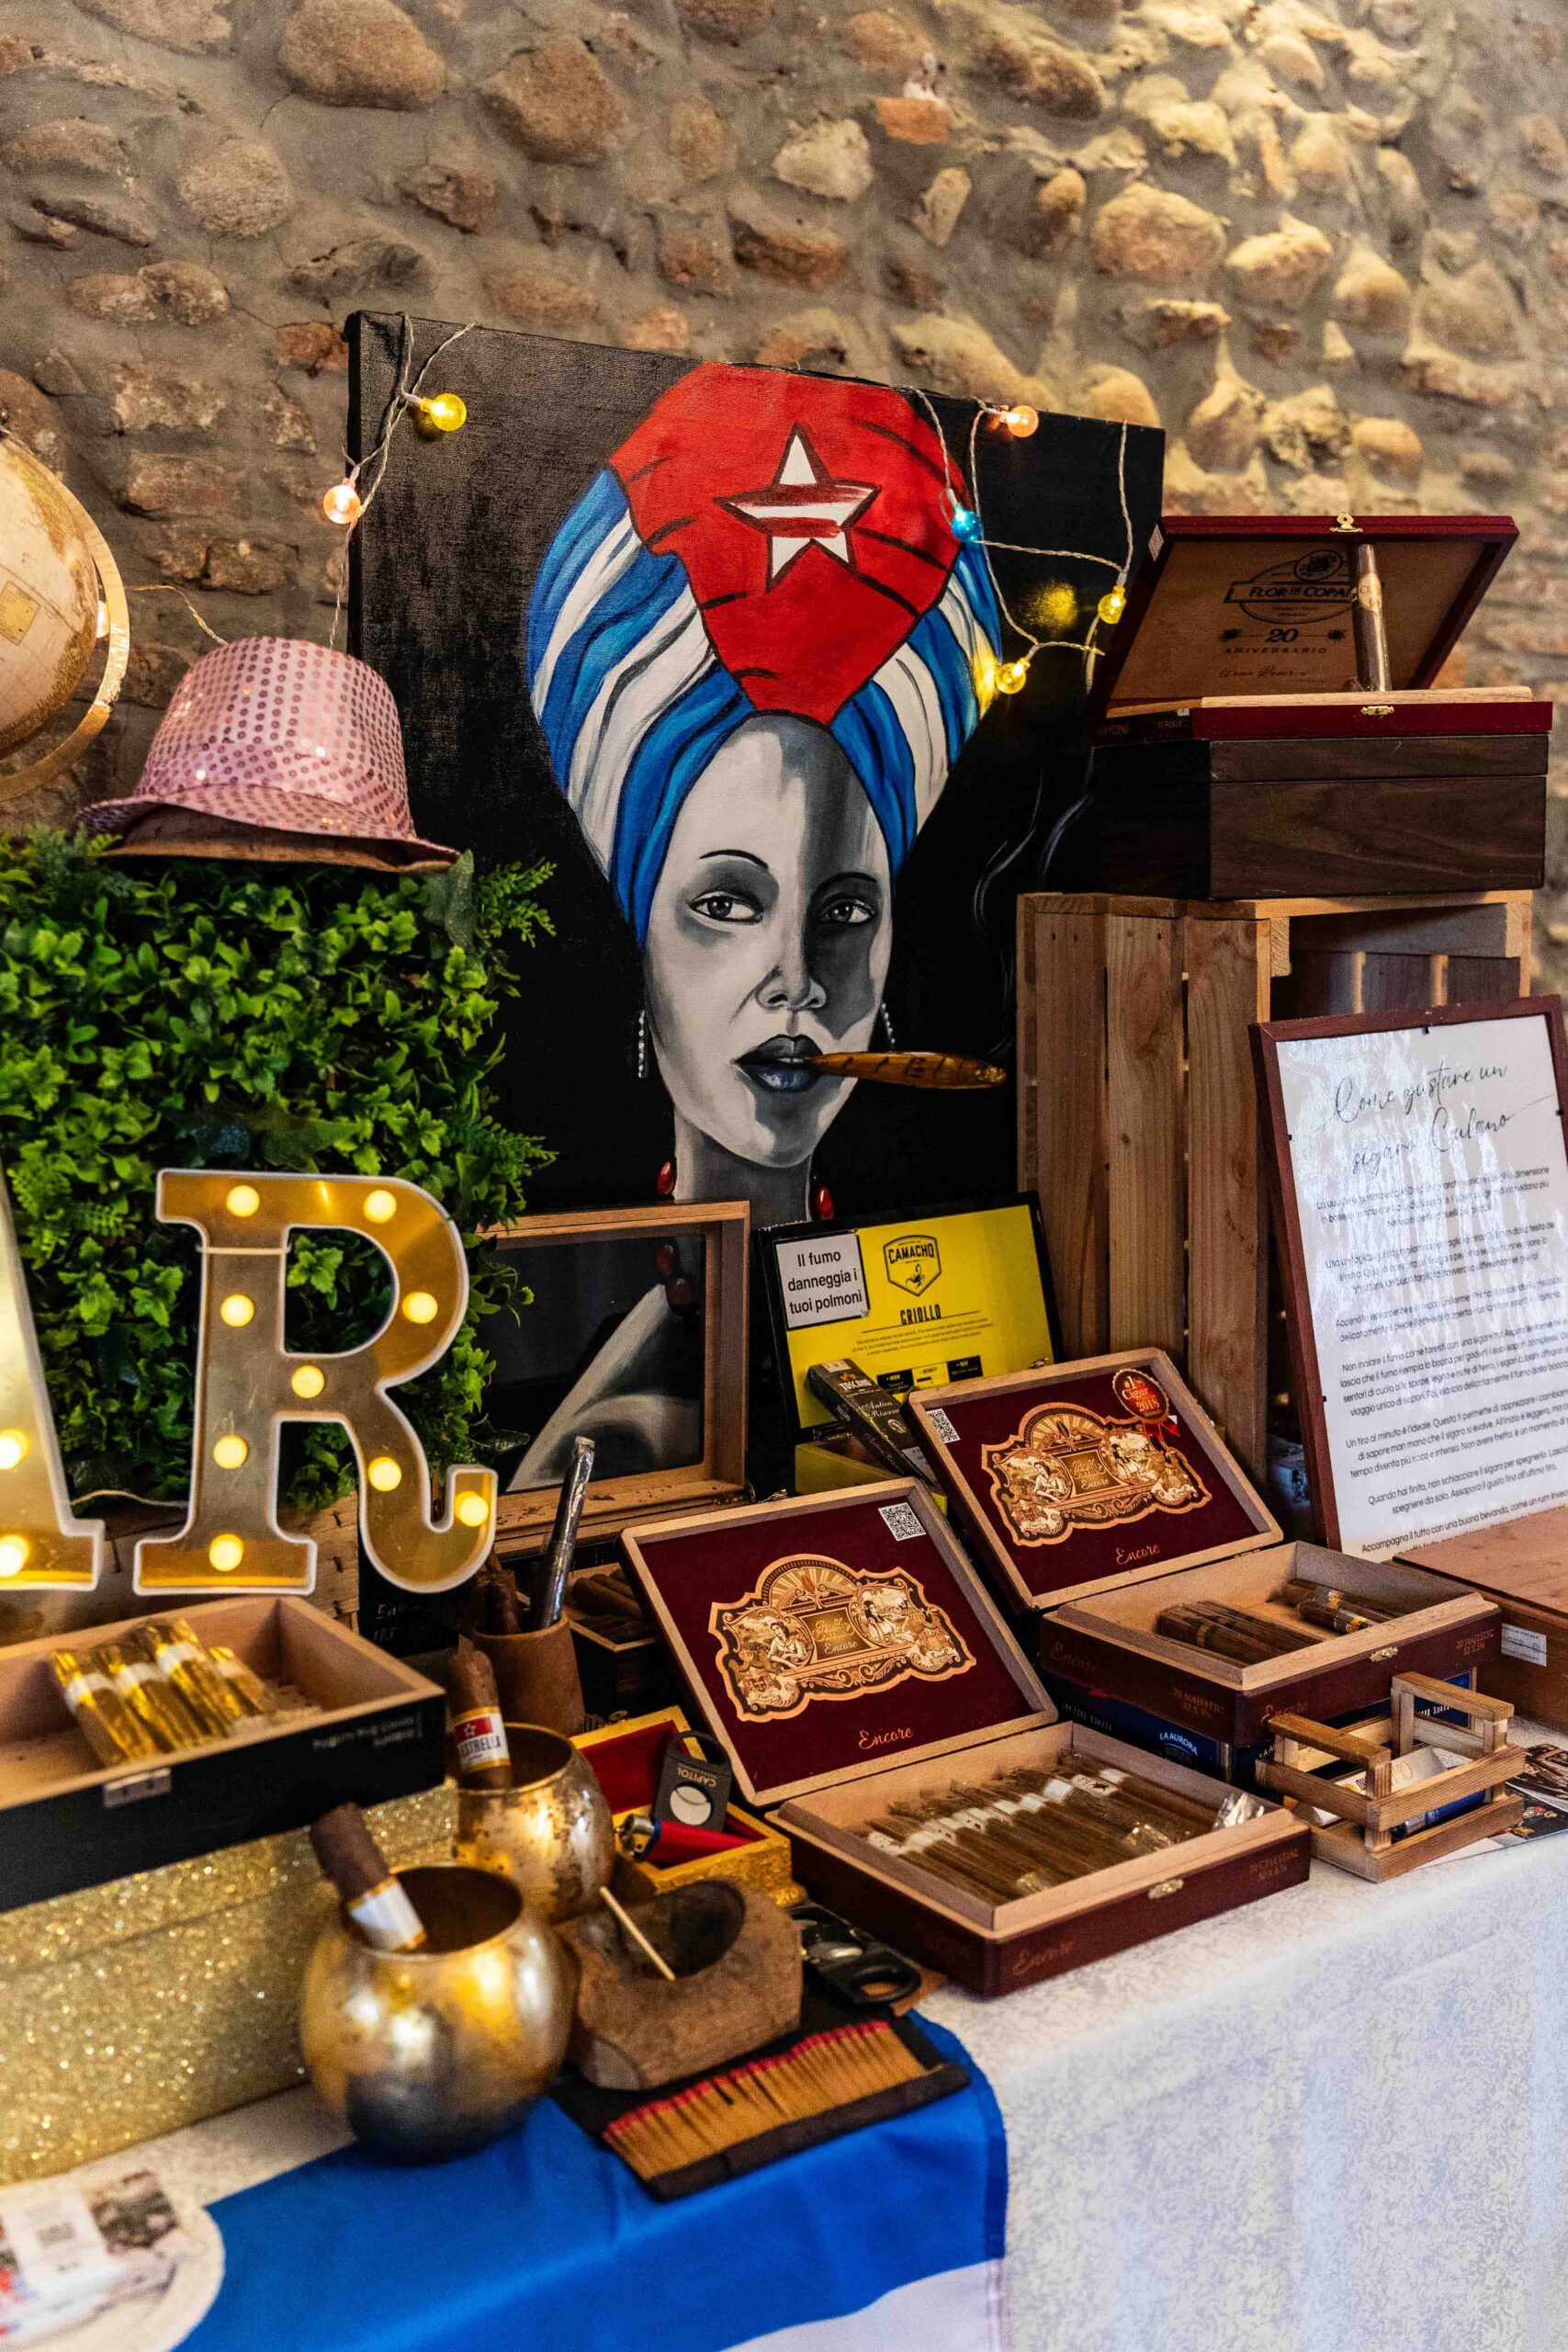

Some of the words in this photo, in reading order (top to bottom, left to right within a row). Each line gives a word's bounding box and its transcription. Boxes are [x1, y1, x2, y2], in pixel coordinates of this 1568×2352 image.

[1248, 585, 1287, 598] FLOR
[1266, 628, 1300, 643] 20
[1333, 1076, 1397, 1124] Come
[1402, 1060, 1472, 1115] gustare
[1479, 1063, 1509, 1081] un
[1430, 1104, 1525, 1153] Cubano
[797, 1253, 807, 1268] Il
[807, 1250, 842, 1267] fumo
[887, 1243, 936, 1265] CAMACHO
[787, 1270, 852, 1293] danneggia
[853, 1268, 859, 1282] i
[789, 1296, 815, 1316] tuoi
[814, 1289, 863, 1314] polmoni
[899, 1303, 942, 1326] CRIOLLO
[1341, 1363, 1357, 1372] Non
[1357, 1357, 1382, 1369] inalare
[1386, 1352, 1404, 1363] fumo
[1404, 1348, 1424, 1358] come
[1424, 1341, 1445, 1354] faresti
[839, 1378, 874, 1392] TOSCANO
[1339, 1376, 1360, 1388] lascia
[1361, 1373, 1374, 1383] che
[1380, 1369, 1397, 1379] fumo
[1122, 1386, 1150, 1401] Cigar
[1135, 1396, 1161, 1413] 2018
[1343, 1389, 1367, 1403] sentori
[1367, 1387, 1374, 1397] di
[1349, 1403, 1375, 1417] viaggio
[1376, 1399, 1395, 1410] unico
[1395, 1396, 1402, 1406] di
[1345, 1439, 1357, 1449] Un
[1357, 1436, 1369, 1446] tiro
[1370, 1433, 1377, 1443] al
[1377, 1428, 1401, 1441] minuto
[1432, 1414, 1456, 1430] Questo
[1457, 1412, 1461, 1421] ti
[1462, 1406, 1492, 1422] permette
[1492, 1403, 1498, 1412] di
[1349, 1466, 1372, 1478] tempo
[1373, 1458, 1399, 1472] diventa
[1400, 1454, 1411, 1467] più
[1461, 1440, 1474, 1450] Non
[1475, 1435, 1494, 1446] avere
[1518, 1427, 1528, 1435] un
[1528, 1418, 1558, 1432] momento
[1358, 1451, 1364, 1461] di
[1365, 1446, 1390, 1459] sapore
[1391, 1442, 1406, 1453] man
[1406, 1437, 1427, 1449] mano
[1427, 1433, 1439, 1443] che
[1440, 1431, 1444, 1440] il
[1445, 1428, 1465, 1440] sigaro
[1466, 1424, 1472, 1433] si
[1081, 1479, 1110, 1490] Encore
[1368, 1490, 1396, 1507] Quando
[1396, 1486, 1408, 1498] hai
[1408, 1482, 1427, 1494] finito,
[1427, 1479, 1440, 1489] non
[1441, 1469, 1478, 1486] schiacciare
[1483, 1463, 1503, 1475] sigaro
[1503, 1459, 1515, 1470] per
[1392, 1498, 1424, 1515] spegnere
[1424, 1495, 1434, 1505] da
[1434, 1491, 1449, 1502] solo.
[1450, 1483, 1481, 1498] Assapora
[1482, 1480, 1485, 1489] il
[1485, 1476, 1505, 1490] gusto
[1505, 1474, 1517, 1483] fino
[1360, 1533, 1408, 1554] Accompagna
[1409, 1531, 1413, 1540] il
[1414, 1527, 1430, 1539] tutto
[1430, 1523, 1443, 1533] con
[1444, 1520, 1457, 1530] una
[1458, 1514, 1478, 1526] buona
[1509, 1499, 1528, 1511] come
[1529, 1497, 1537, 1506] un
[1537, 1493, 1550, 1503] rum
[1115, 1542, 1161, 1566] Encore
[824, 1641, 858, 1655] Encore
[857, 1724, 915, 1751] Encore
[1158, 1731, 1169, 1742] LA
[1168, 1732, 1200, 1758] AURORA
[676, 1766, 716, 1788] CAPITOL
